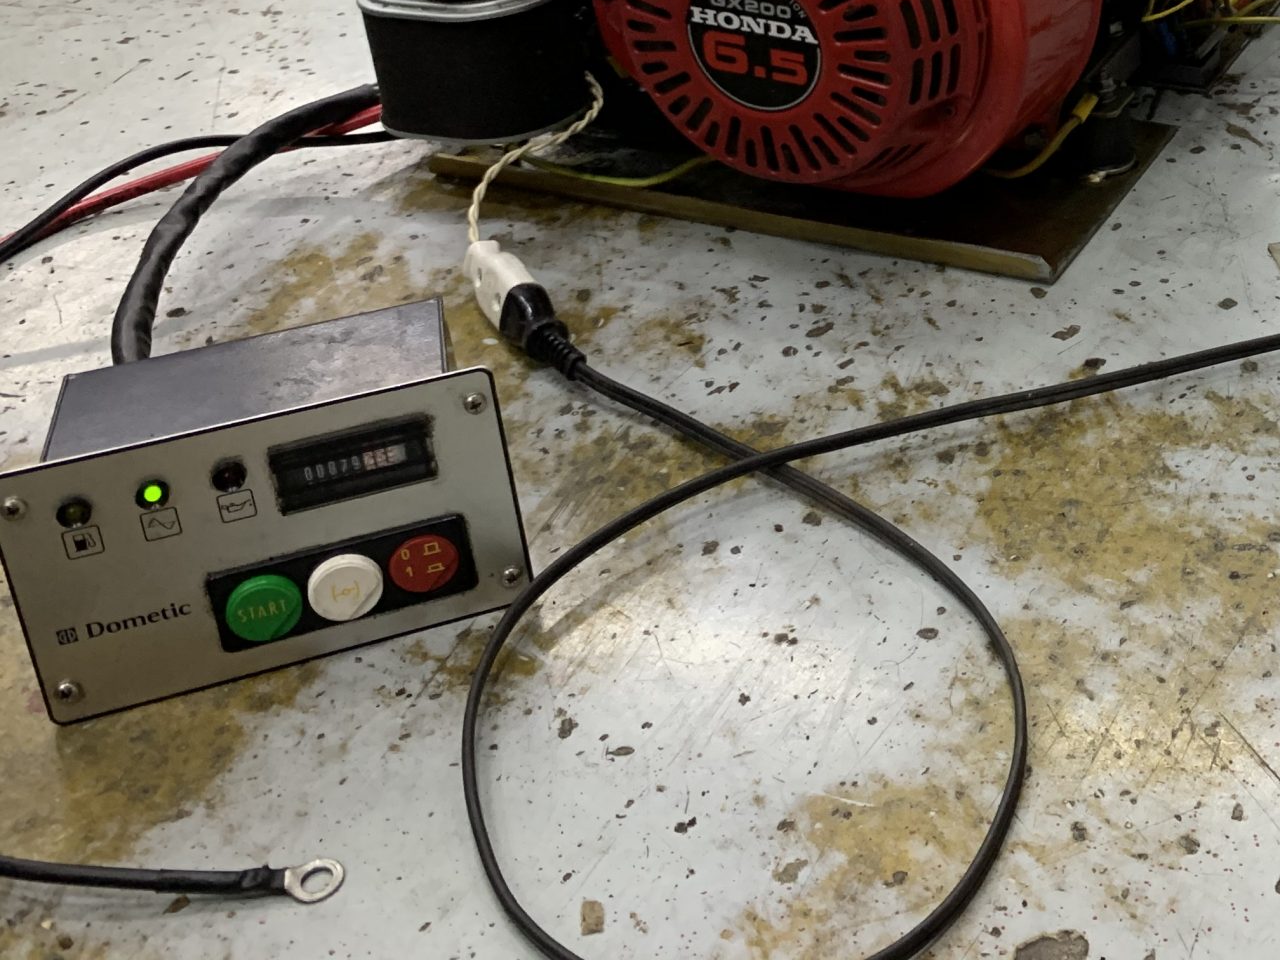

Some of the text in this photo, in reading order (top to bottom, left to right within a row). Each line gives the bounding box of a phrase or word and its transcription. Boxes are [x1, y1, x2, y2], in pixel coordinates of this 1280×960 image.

[690, 5, 819, 45] HONDA
[703, 30, 808, 86] 6.5
[400, 548, 410, 560] 0
[405, 566, 414, 577] 1
[85, 602, 192, 639] Dometic
[237, 600, 288, 625] START
